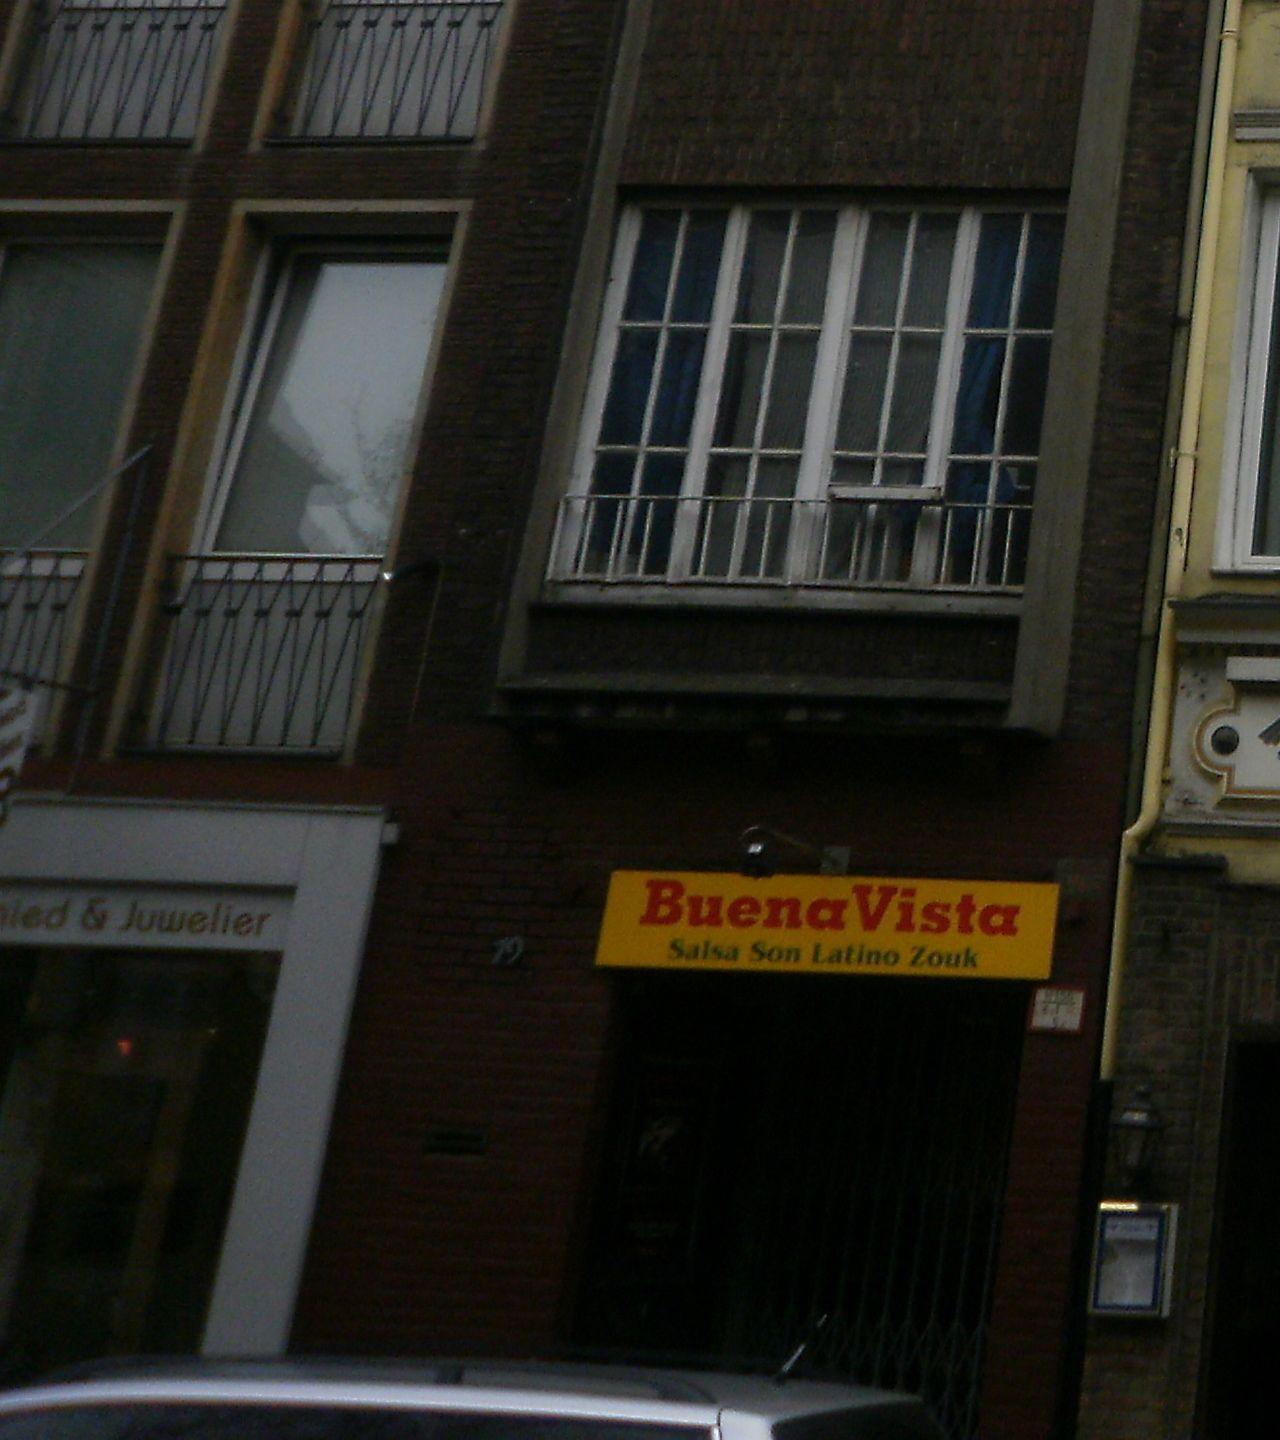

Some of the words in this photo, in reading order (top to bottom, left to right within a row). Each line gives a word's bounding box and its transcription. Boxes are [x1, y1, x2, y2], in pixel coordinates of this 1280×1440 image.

[119, 899, 272, 936] Juwelier
[667, 938, 740, 963] Salsa
[750, 939, 800, 964] Son
[812, 940, 900, 968] Latino
[909, 945, 978, 970] Zouk
